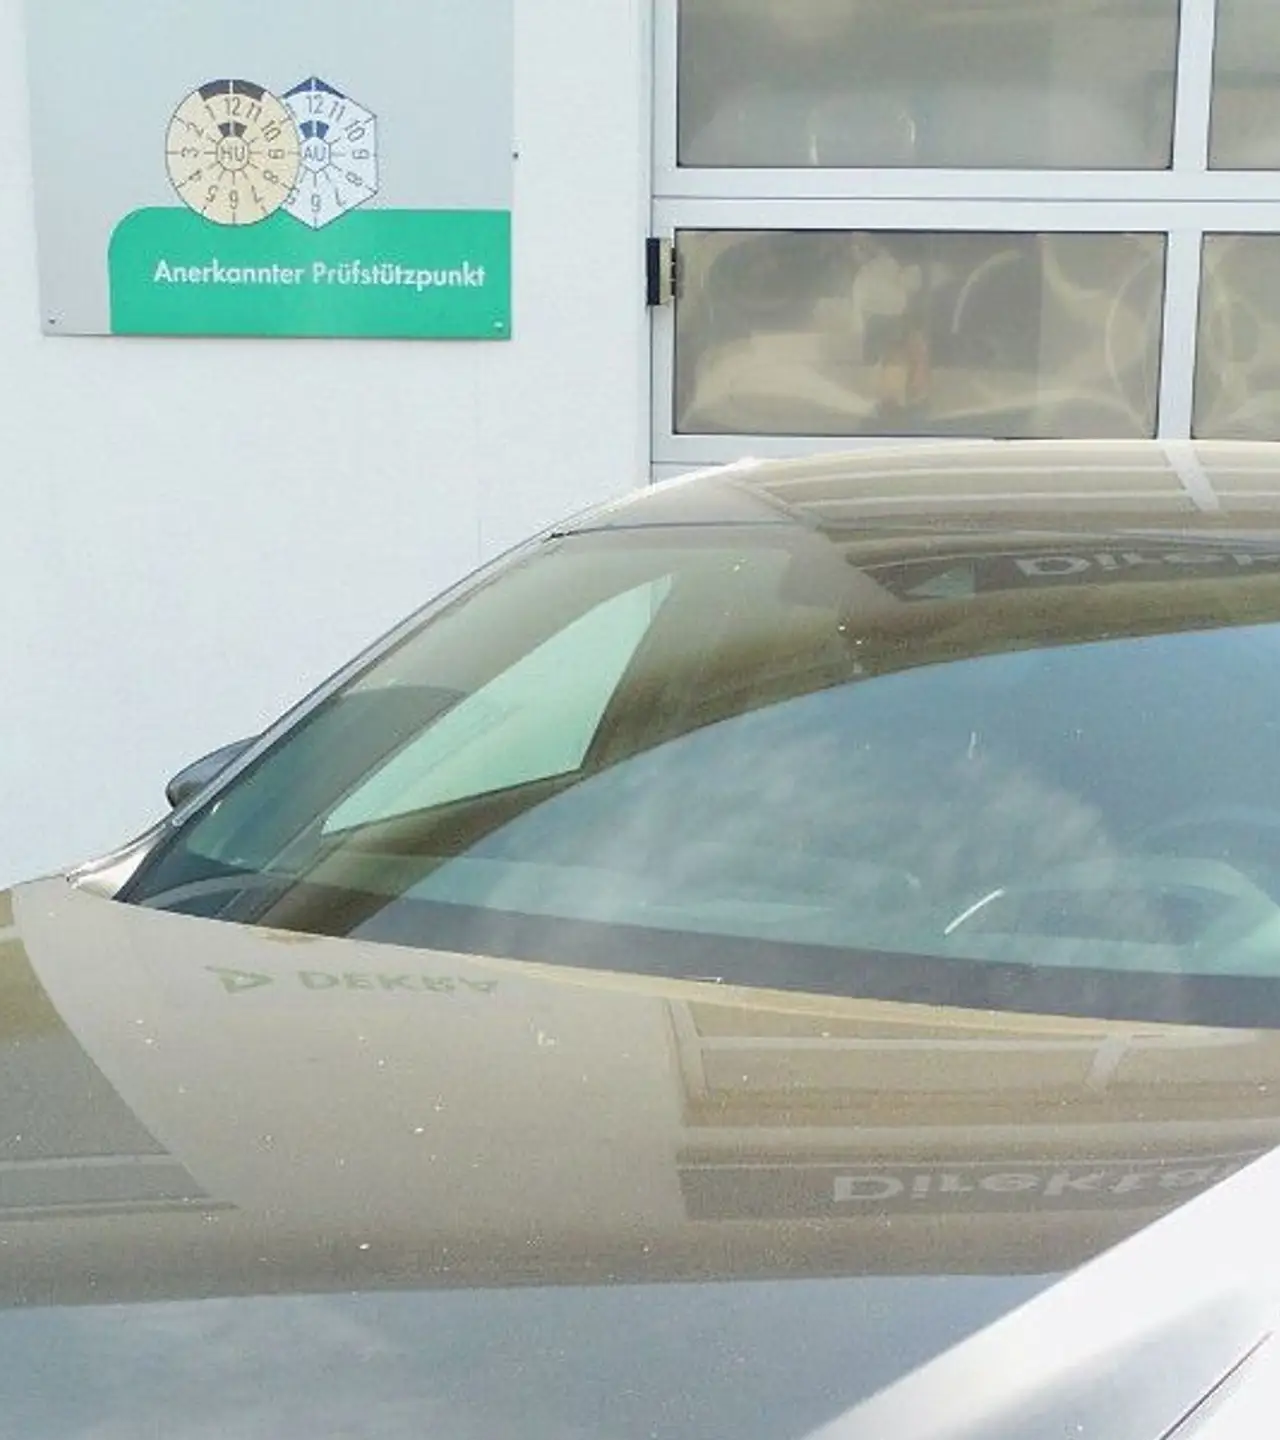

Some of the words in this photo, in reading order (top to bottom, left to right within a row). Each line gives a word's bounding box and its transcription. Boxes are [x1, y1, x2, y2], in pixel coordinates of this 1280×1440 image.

[224, 96, 241, 116] 12
[246, 102, 262, 122] 11
[305, 94, 324, 115] 12
[328, 100, 347, 122] 11
[261, 119, 283, 142] 10
[343, 119, 365, 142] 10
[220, 145, 246, 162] HU
[303, 145, 327, 162] AU
[153, 258, 305, 285] Anerkannter
[312, 259, 486, 292] Prüfstützpunkt
